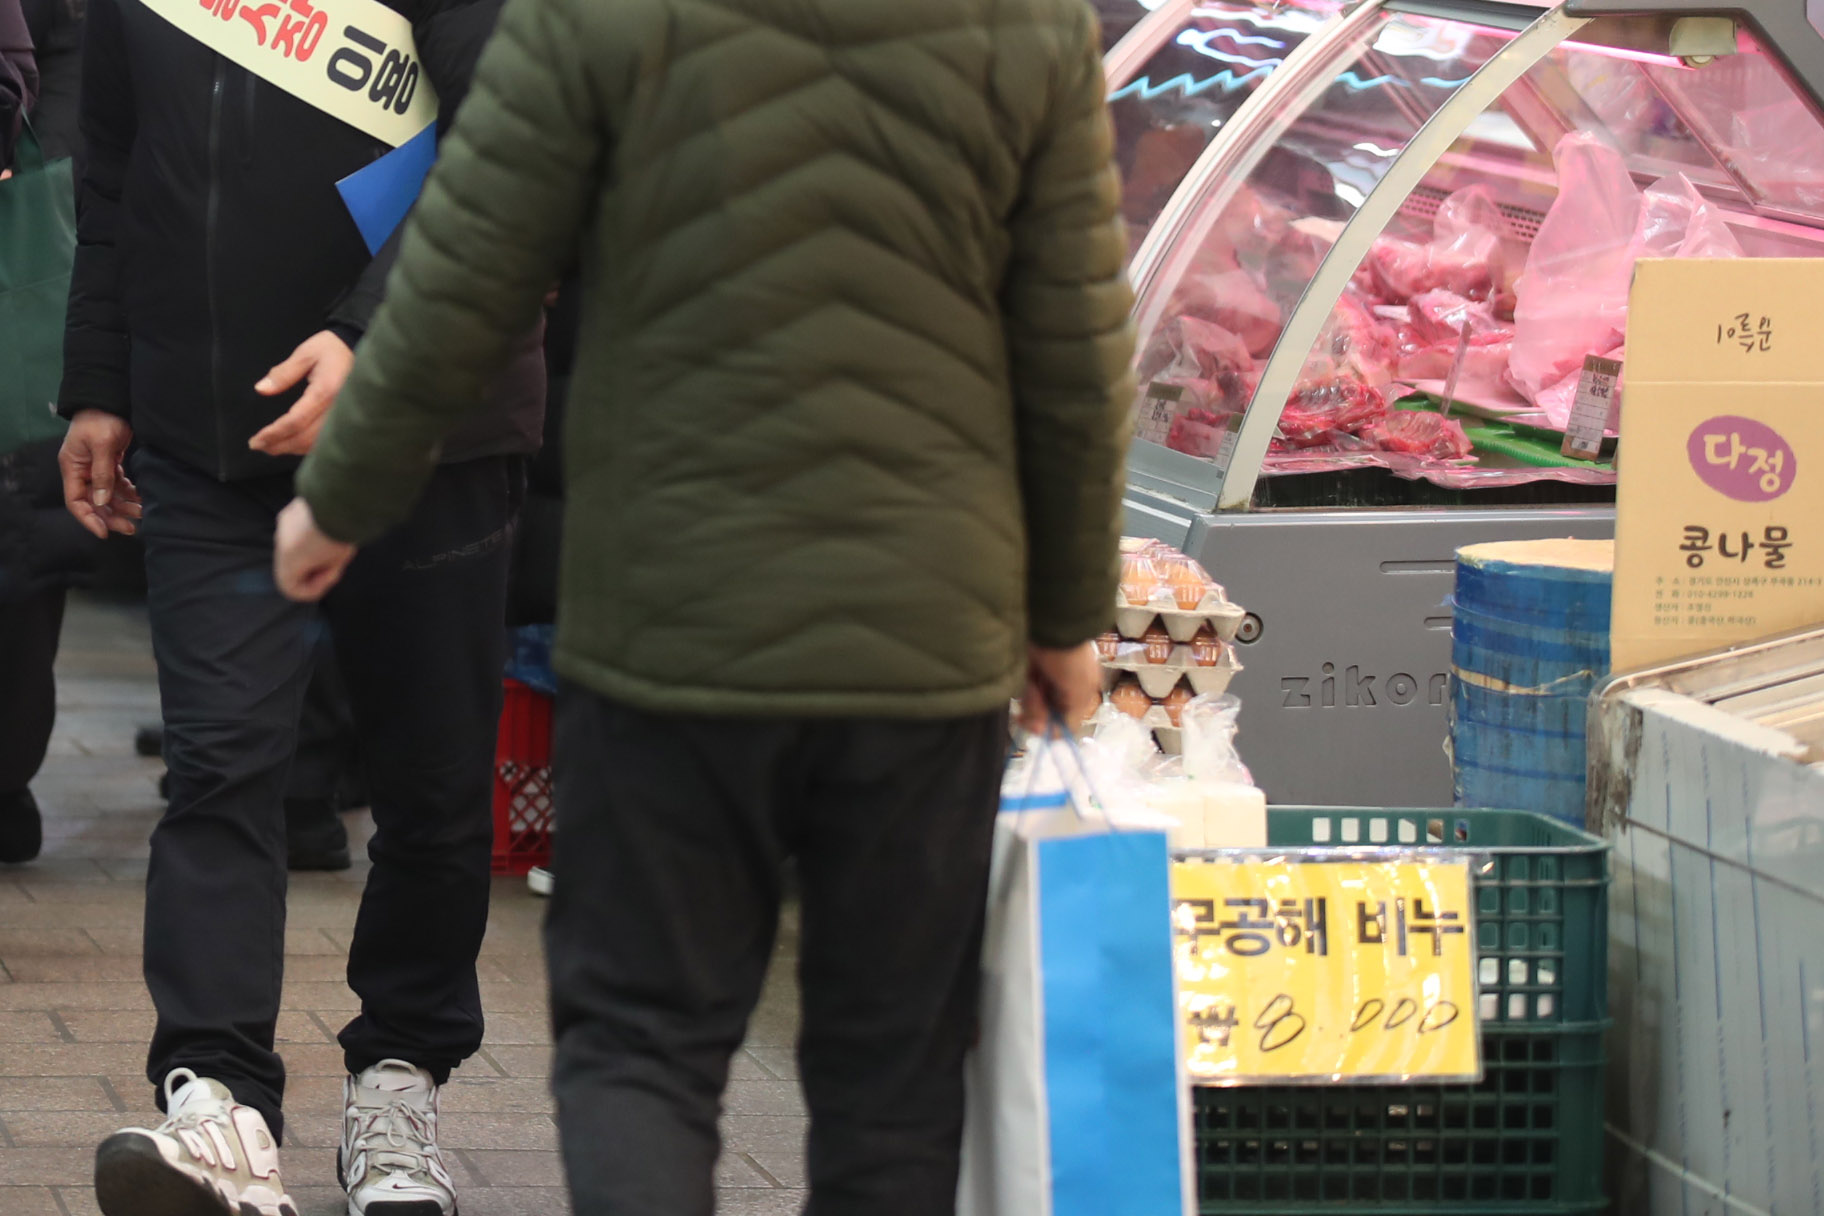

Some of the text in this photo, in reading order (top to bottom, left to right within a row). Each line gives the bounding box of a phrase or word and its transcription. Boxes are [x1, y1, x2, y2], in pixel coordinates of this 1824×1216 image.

[326, 24, 419, 115] 이용
[1702, 431, 1784, 493] 다정
[1678, 525, 1794, 570] 콩나물
[1280, 662, 1448, 709] zikor
[1173, 897, 1465, 957] 무공해 비누
